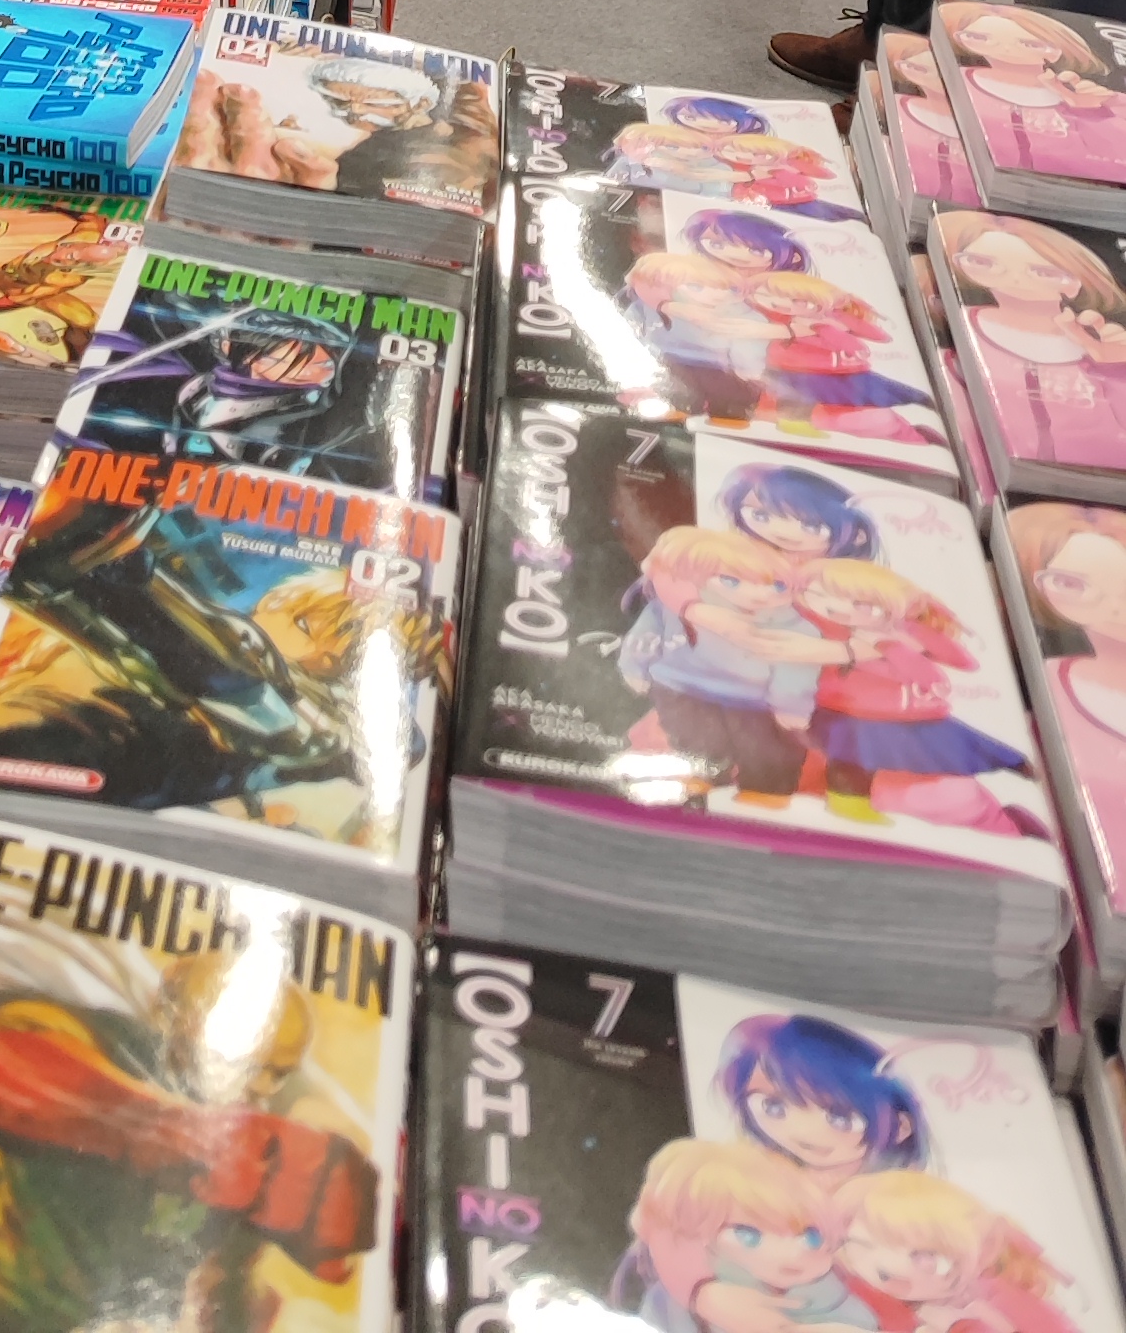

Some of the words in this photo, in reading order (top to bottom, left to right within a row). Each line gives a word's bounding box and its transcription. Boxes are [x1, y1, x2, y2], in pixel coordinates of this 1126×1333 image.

[220, 37, 269, 60] 04
[70, 134, 117, 165] 100
[8, 160, 101, 195] PSYCHO
[104, 168, 154, 198] 100
[95, 195, 150, 223] MA
[139, 252, 365, 328] ONE-PUNCH
[371, 294, 458, 345] MAN
[377, 333, 439, 369] 03
[625, 429, 661, 465] 7
[61, 449, 334, 537] ONE-PUNCH
[341, 495, 447, 564] MAN
[221, 534, 277, 555] YUSUKE
[279, 543, 341, 567] MURATA
[349, 549, 423, 596] 02
[588, 973, 636, 1039] 7
[452, 975, 534, 1190] OSHI
[457, 1185, 543, 1235] NO
